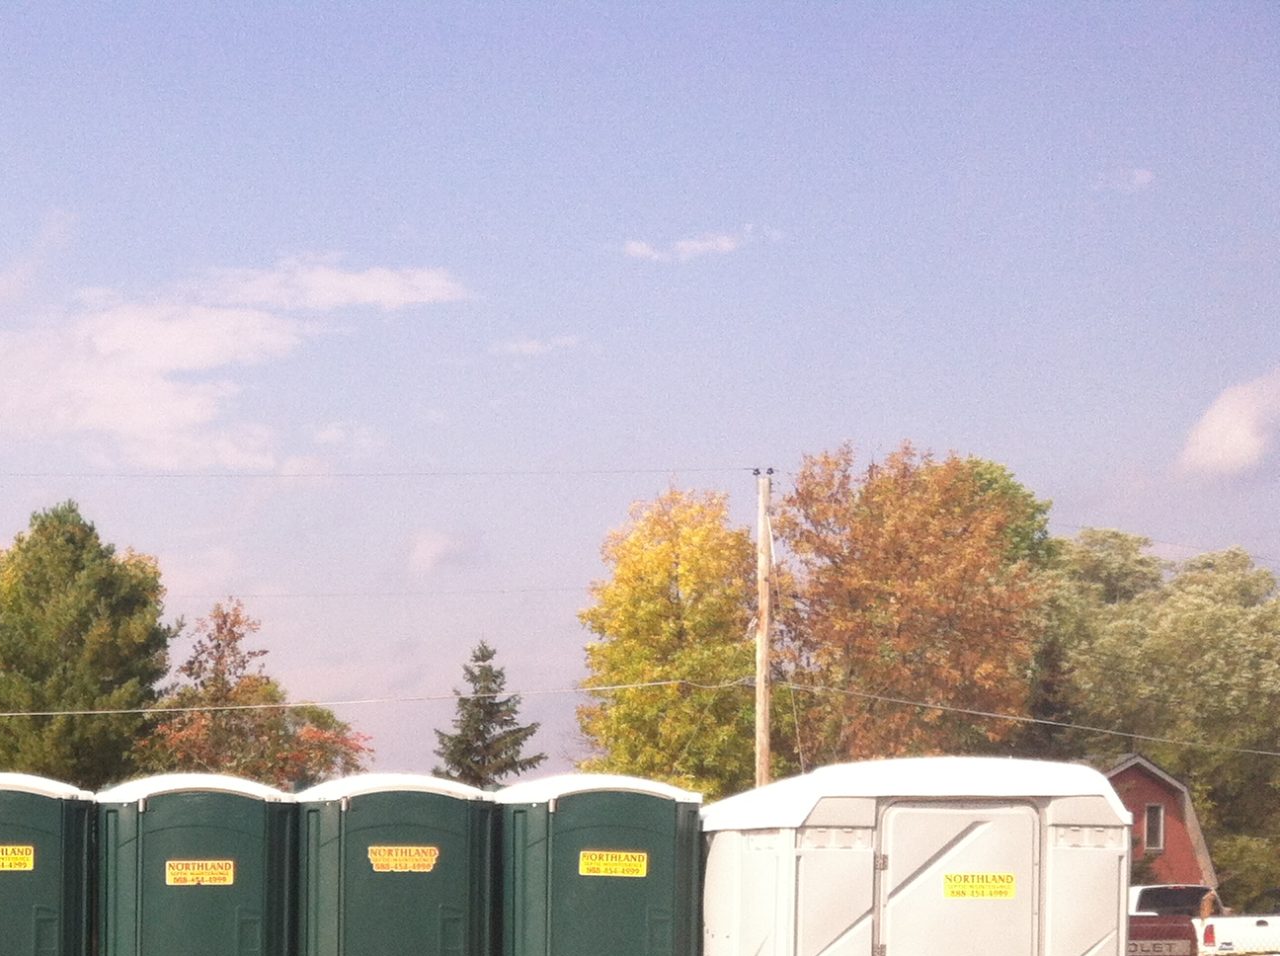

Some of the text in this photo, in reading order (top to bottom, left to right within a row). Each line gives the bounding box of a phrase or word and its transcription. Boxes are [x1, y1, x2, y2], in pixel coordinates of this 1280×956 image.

[370, 848, 436, 857] NORTHLAND
[581, 853, 645, 862] NORTHLAND
[168, 862, 232, 871] NORTHLAND
[944, 874, 1014, 884] NORTHLAND
